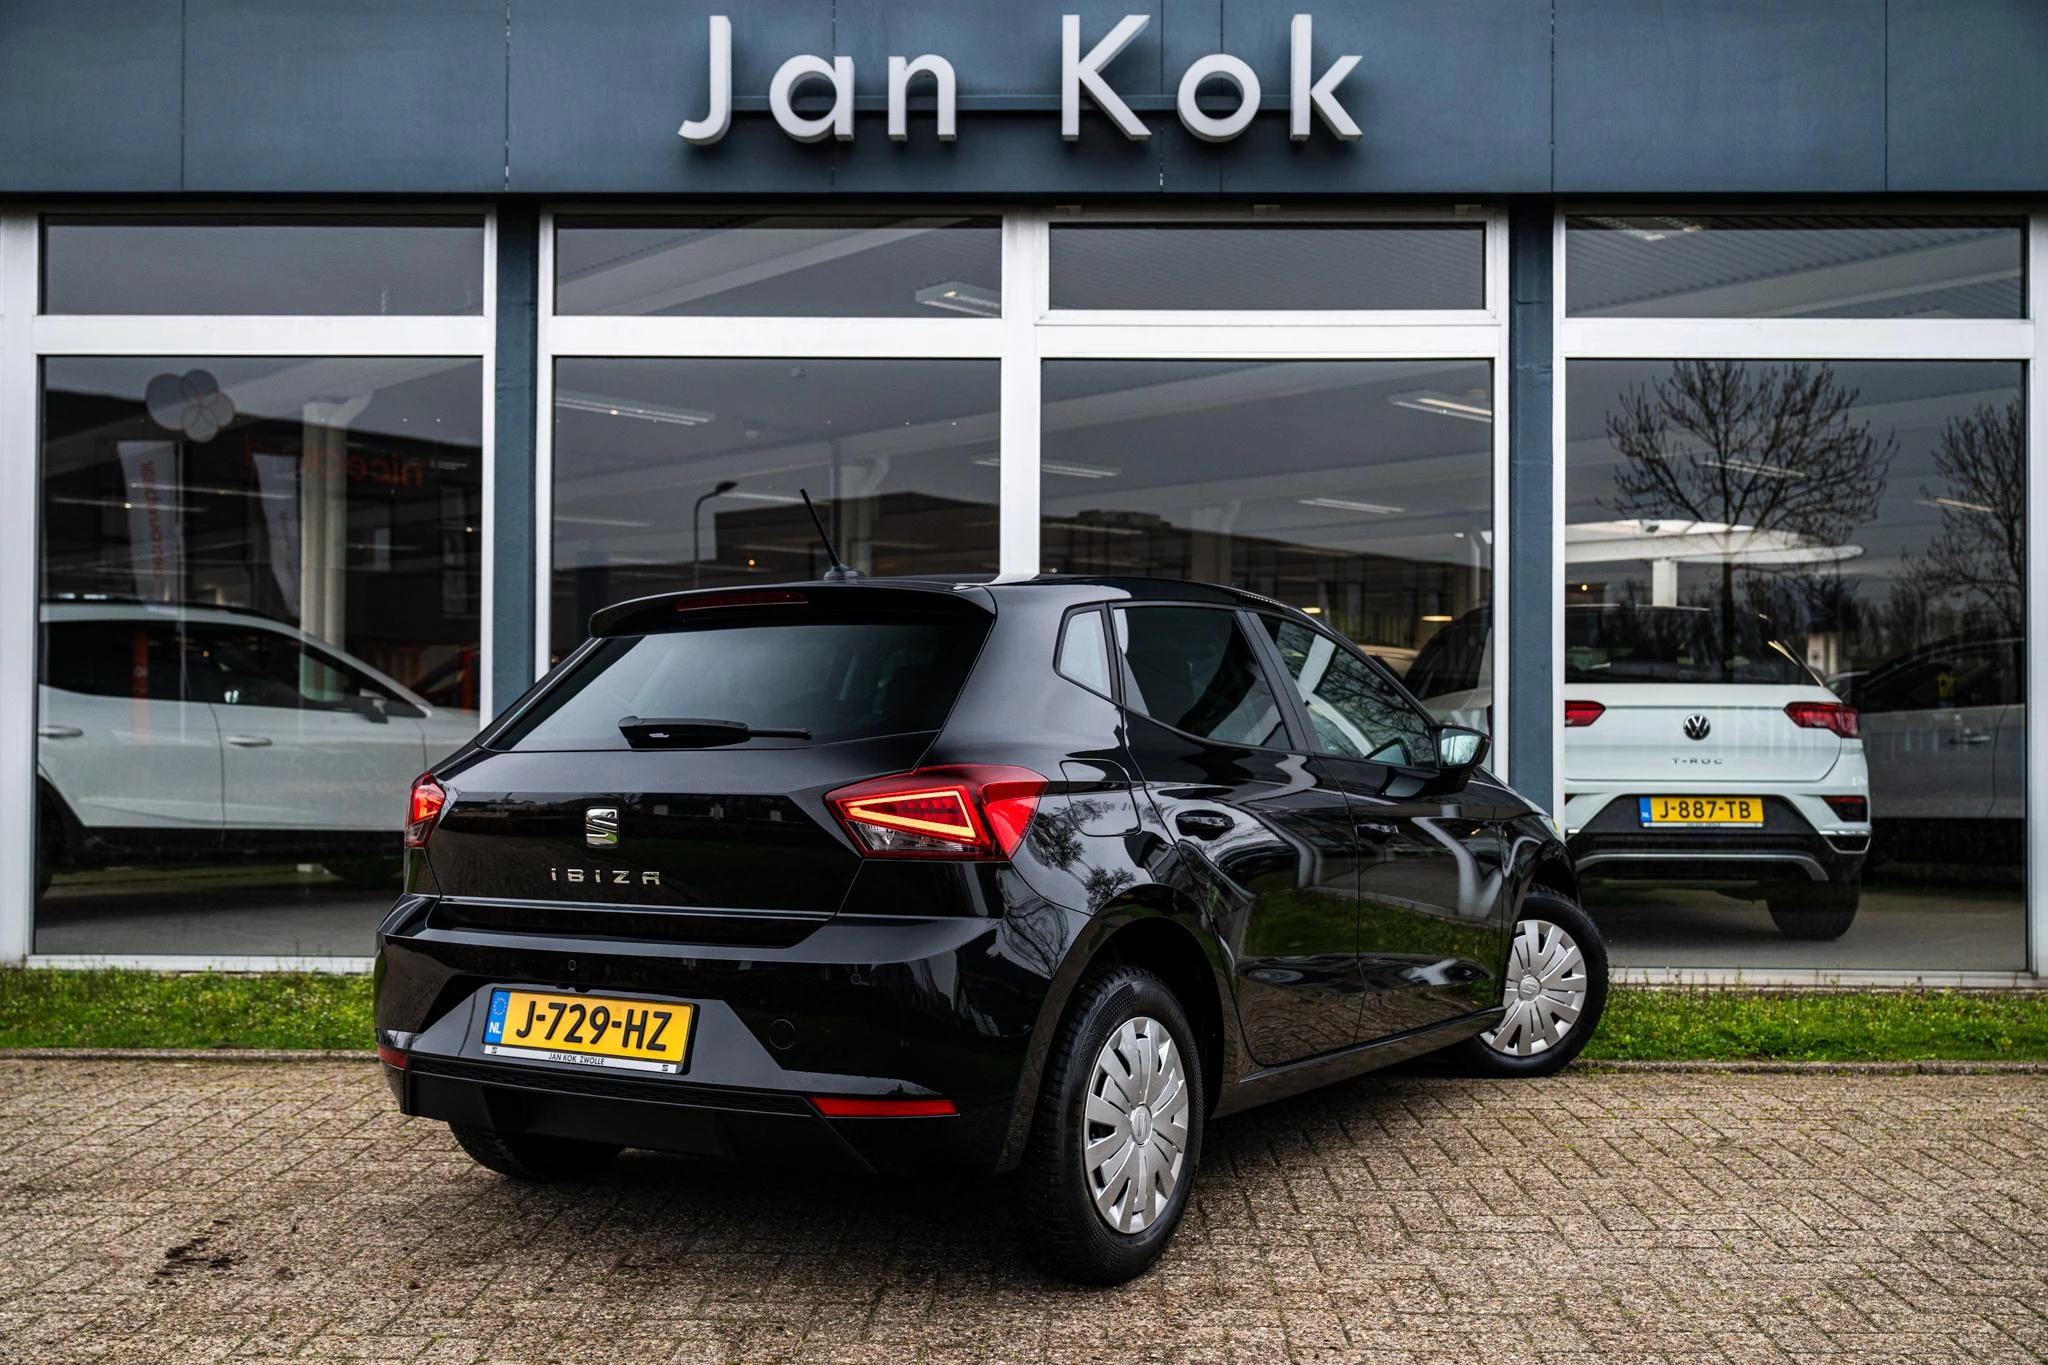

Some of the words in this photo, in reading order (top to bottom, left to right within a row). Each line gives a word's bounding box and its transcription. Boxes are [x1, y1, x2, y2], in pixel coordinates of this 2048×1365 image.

[678, 14, 957, 144] Jan
[1061, 13, 1363, 143] Kok
[1671, 757, 1723, 765] T-ROC
[1659, 800, 1751, 819] J-887-TB
[488, 1021, 502, 1035] NL
[515, 1000, 673, 1052] J-729-HZ
[548, 1052, 561, 1061] JAN
[563, 1054, 577, 1063] KOK
[579, 1056, 605, 1066] ZWOLLE
